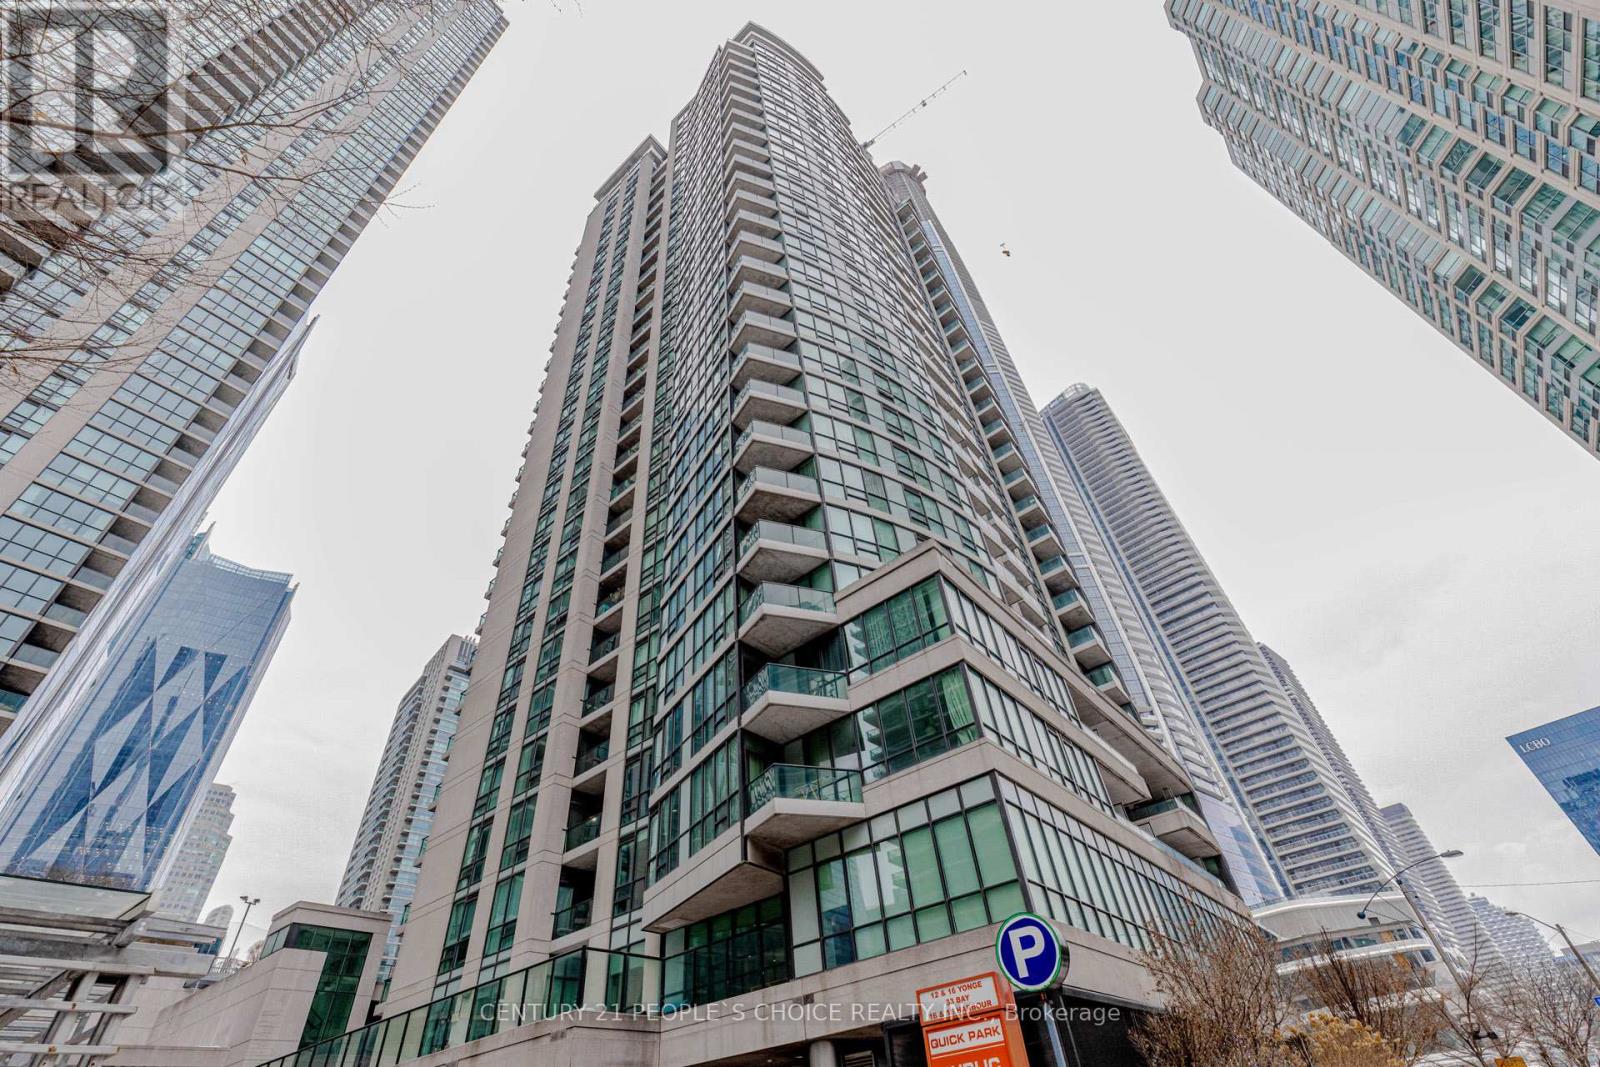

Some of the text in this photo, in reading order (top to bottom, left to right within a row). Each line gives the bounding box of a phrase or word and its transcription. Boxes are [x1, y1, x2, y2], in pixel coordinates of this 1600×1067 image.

[1520, 737, 1550, 753] LCBO
[1008, 925, 1045, 979] P
[931, 991, 938, 999] 12
[957, 981, 982, 992] YONGE
[956, 994, 969, 1003] BAY
[930, 1026, 1001, 1049] QUICK PARK
